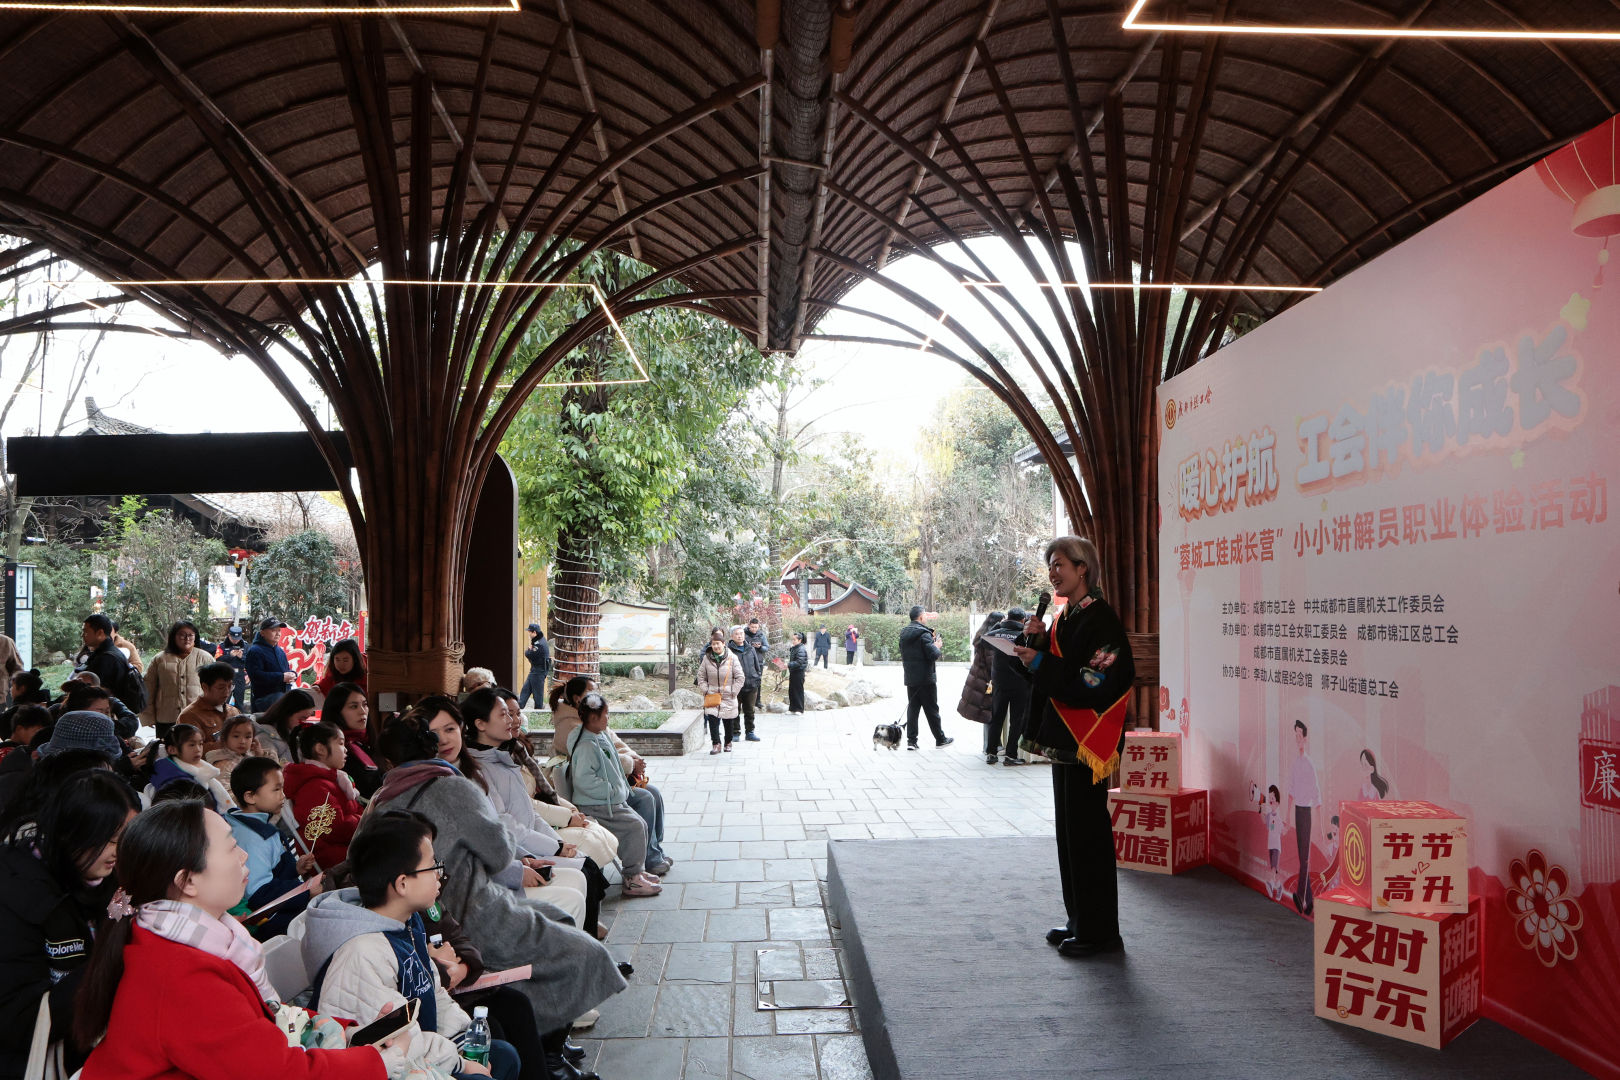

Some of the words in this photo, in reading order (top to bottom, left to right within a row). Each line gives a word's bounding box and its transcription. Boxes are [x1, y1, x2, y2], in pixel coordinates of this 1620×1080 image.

[1178, 425, 1279, 520] 暖心护航
[1295, 322, 1585, 490] 工会伴你成长
[1303, 593, 1445, 615] 中共成都市直属机关工作委员会
[1357, 624, 1459, 644] 成都市锦江区总工会
[1253, 645, 1348, 666] 成都市直属机关工会委员会
[1321, 673, 1399, 699] 狮子山街道总工会
[1126, 745, 1169, 762] 节节
[1126, 770, 1169, 788] 高升
[1110, 797, 1168, 831] 万事
[1113, 830, 1169, 867] 如意
[1383, 832, 1454, 860] 节节
[1382, 874, 1454, 903] 高升
[1323, 913, 1428, 975] 及时
[1324, 967, 1428, 1033] 行乐
